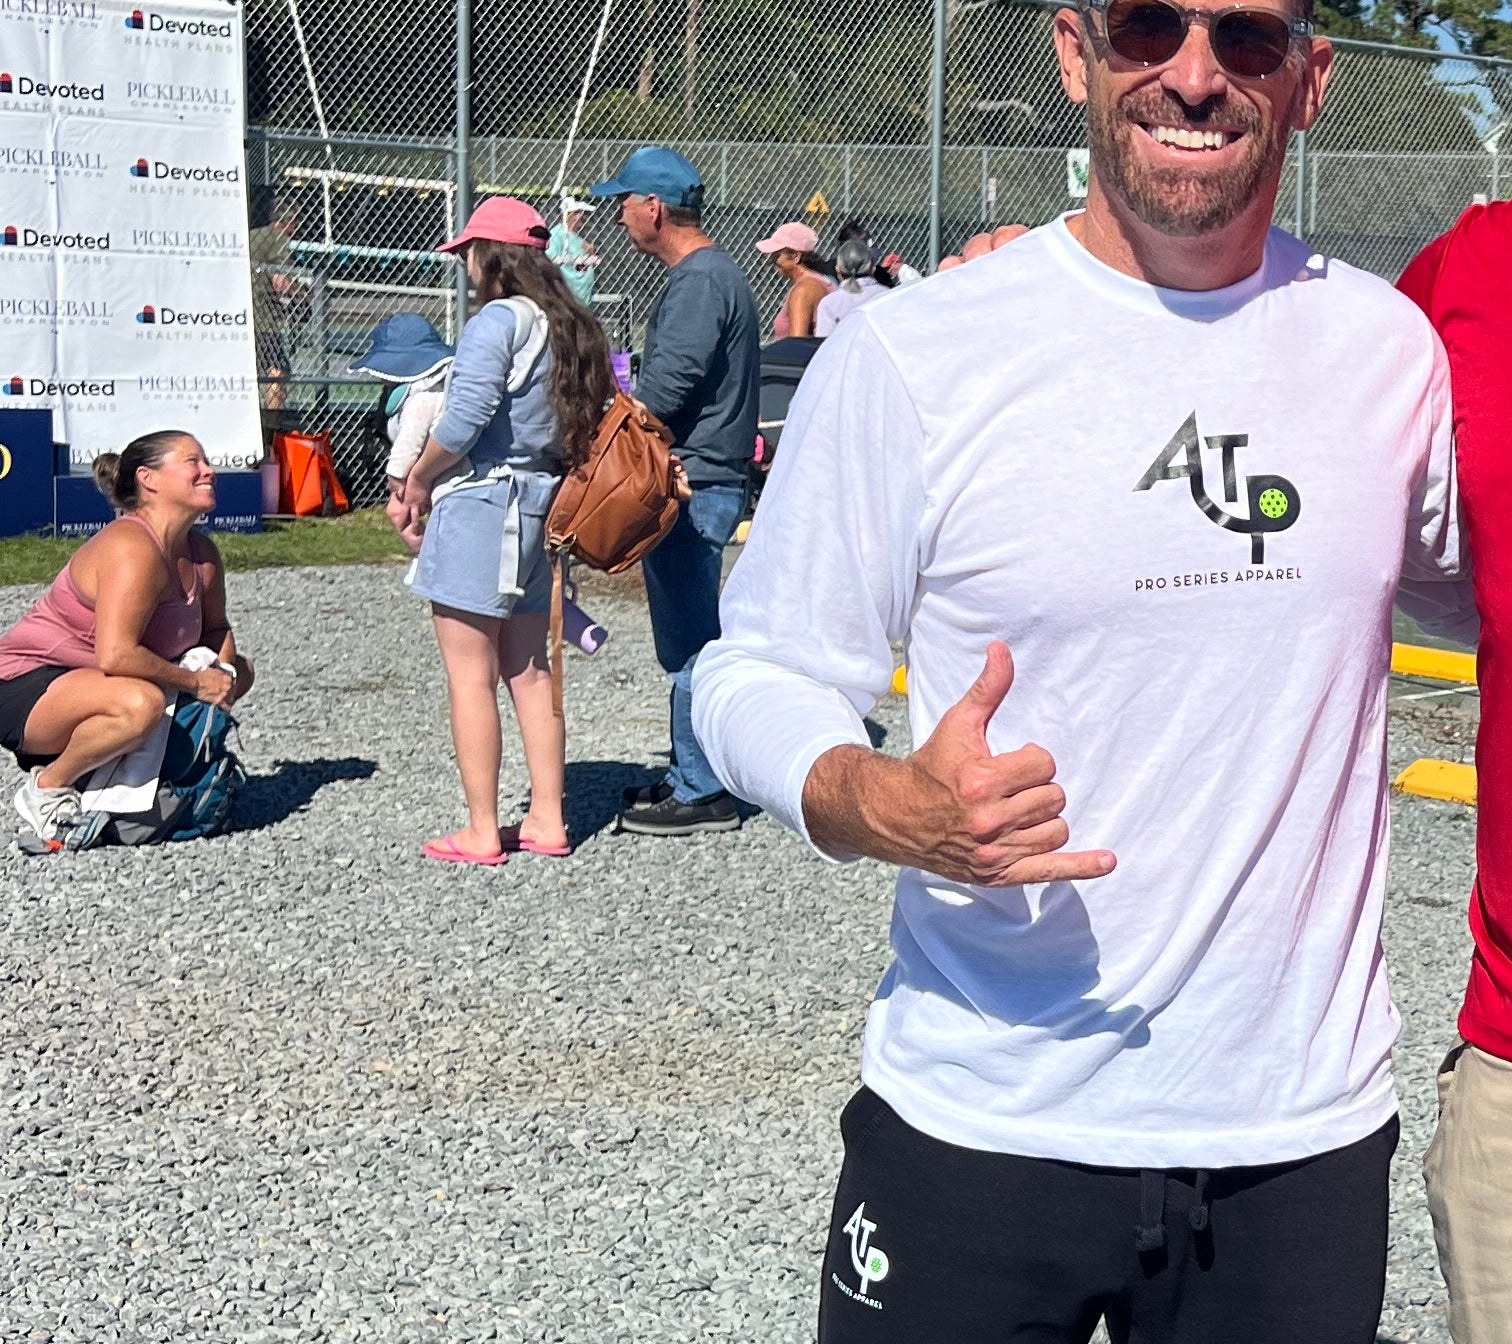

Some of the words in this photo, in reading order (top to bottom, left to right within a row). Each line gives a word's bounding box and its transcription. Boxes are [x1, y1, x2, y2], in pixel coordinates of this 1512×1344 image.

[5, 13, 98, 29] HARLESTON
[150, 13, 231, 38] Devoted
[124, 36, 180, 49] HEALTH
[187, 40, 233, 53] PLANS
[19, 76, 104, 101] Devoted
[127, 81, 236, 105] PICKLEBALL
[3, 100, 51, 113] EALTH
[154, 161, 239, 182] Devoted
[129, 183, 185, 195] HEALTH
[193, 187, 240, 198] PLANS
[23, 228, 110, 250] Devoted
[133, 229, 244, 249] PICKLEBALL
[0, 298, 114, 318] PICKLEBALL
[161, 307, 247, 326] Devoted
[136, 330, 193, 341] HEALTH
[201, 331, 249, 342] PLANS
[30, 378, 115, 396] Devoted
[139, 375, 252, 392] PICKLEBALL
[1131, 409, 1301, 564] ATP
[1135, 577, 1167, 592] PRO
[1173, 571, 1228, 588] SERIES
[1235, 567, 1302, 583] APPAREL
[842, 1201, 889, 1295] ATP
